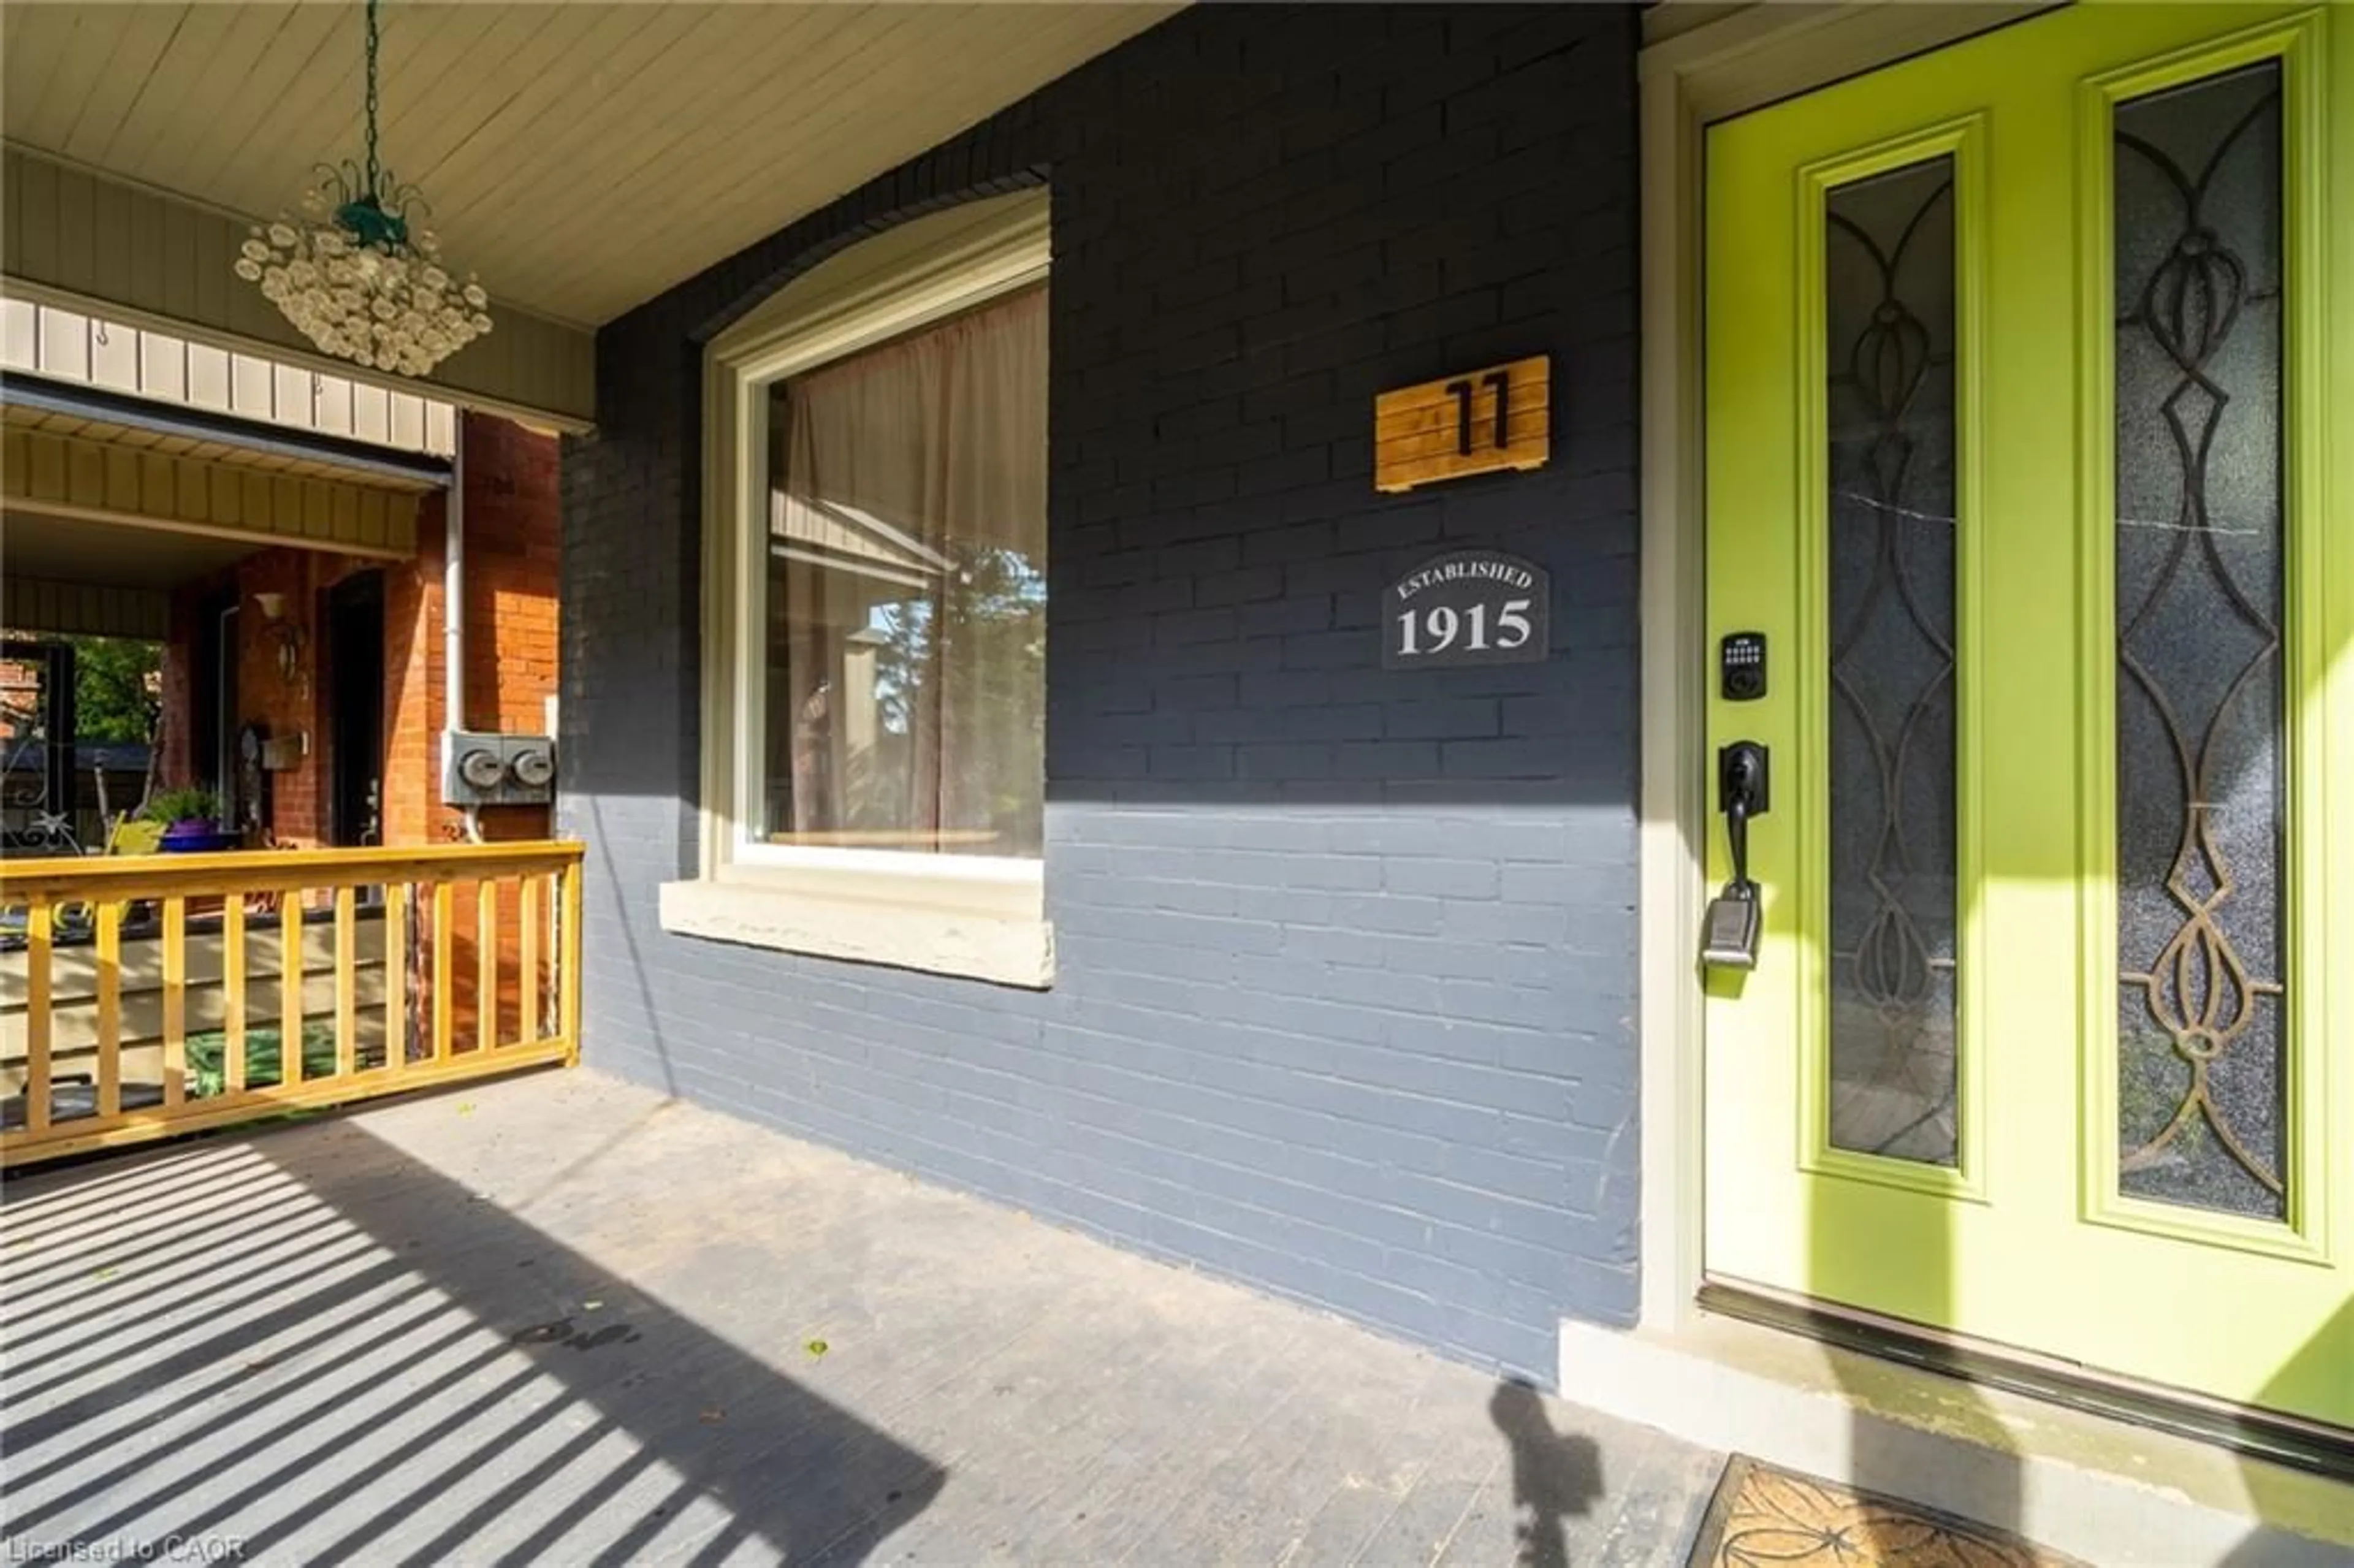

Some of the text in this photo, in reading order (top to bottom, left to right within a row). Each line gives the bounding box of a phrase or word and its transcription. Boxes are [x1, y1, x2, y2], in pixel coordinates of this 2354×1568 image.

[1446, 371, 1509, 455] 11
[1398, 561, 1533, 599] ESTABLISHED
[1398, 599, 1531, 654] 1915
